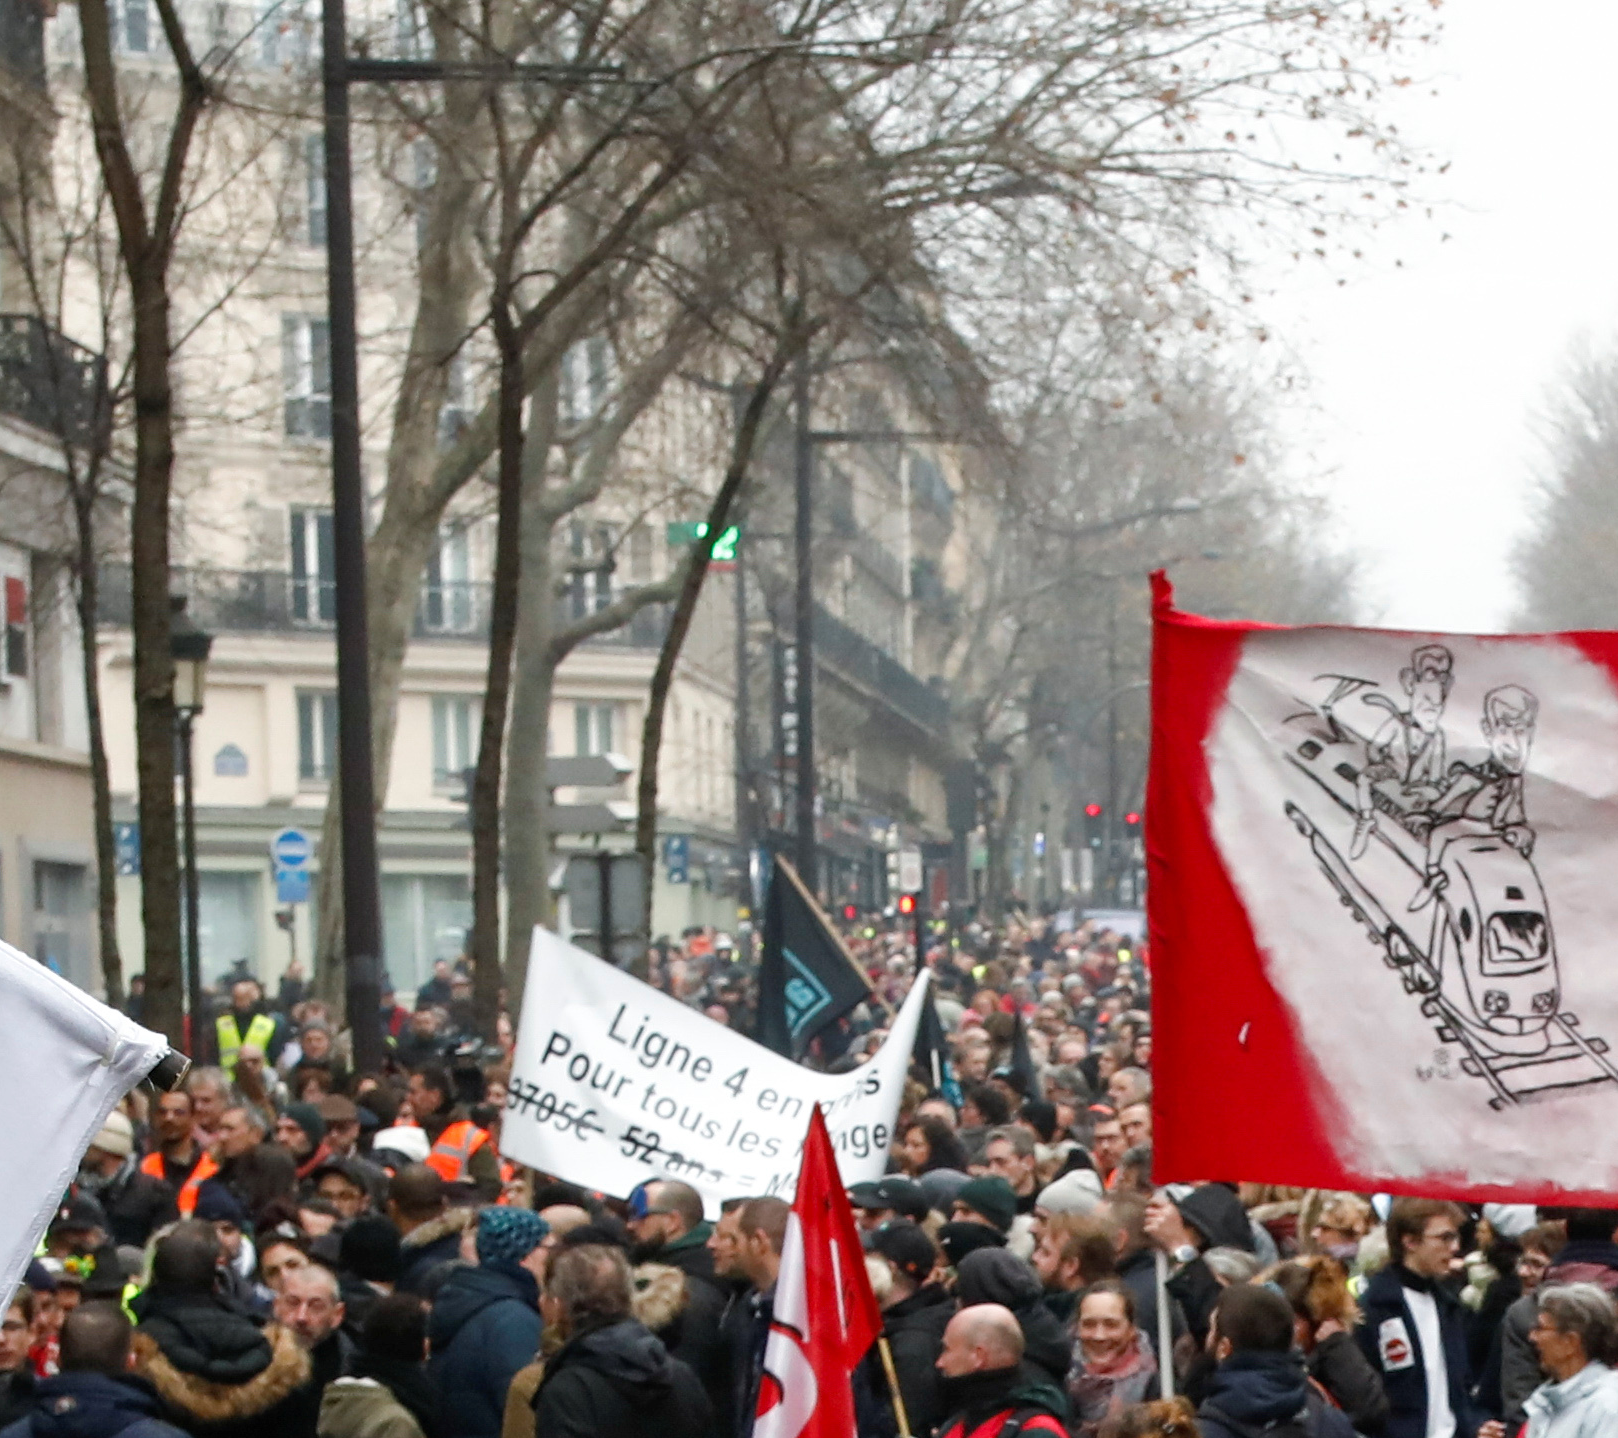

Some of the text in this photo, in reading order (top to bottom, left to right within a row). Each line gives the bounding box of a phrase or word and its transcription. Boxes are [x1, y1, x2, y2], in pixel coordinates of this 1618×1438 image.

[541, 1031, 632, 1100] Pour
[640, 1082, 719, 1141] tous
[726, 1119, 782, 1158] les
[608, 1002, 713, 1083] Ligne
[723, 1066, 751, 1098] 4
[757, 1087, 803, 1119] en
